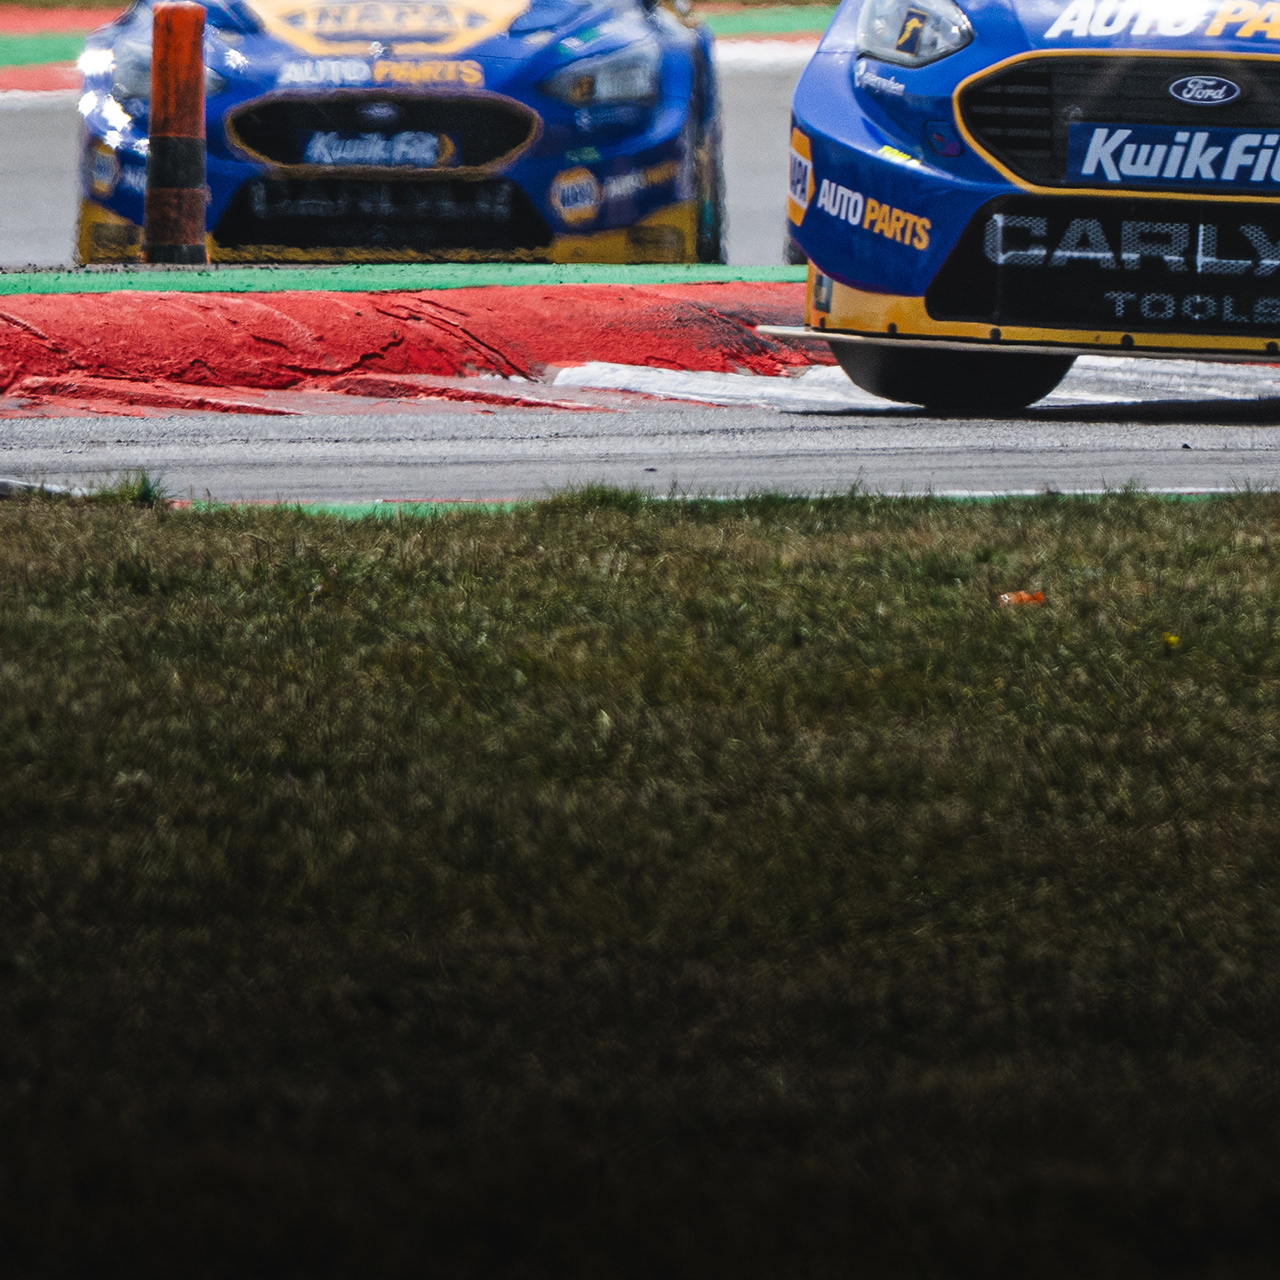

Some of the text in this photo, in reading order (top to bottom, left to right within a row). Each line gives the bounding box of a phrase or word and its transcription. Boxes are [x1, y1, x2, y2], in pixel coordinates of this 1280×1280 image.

[1044, 0, 1208, 38] AUTO
[275, 58, 372, 86] AUTO
[1181, 78, 1228, 102] Ford
[817, 179, 931, 251] AUTO PARTS
